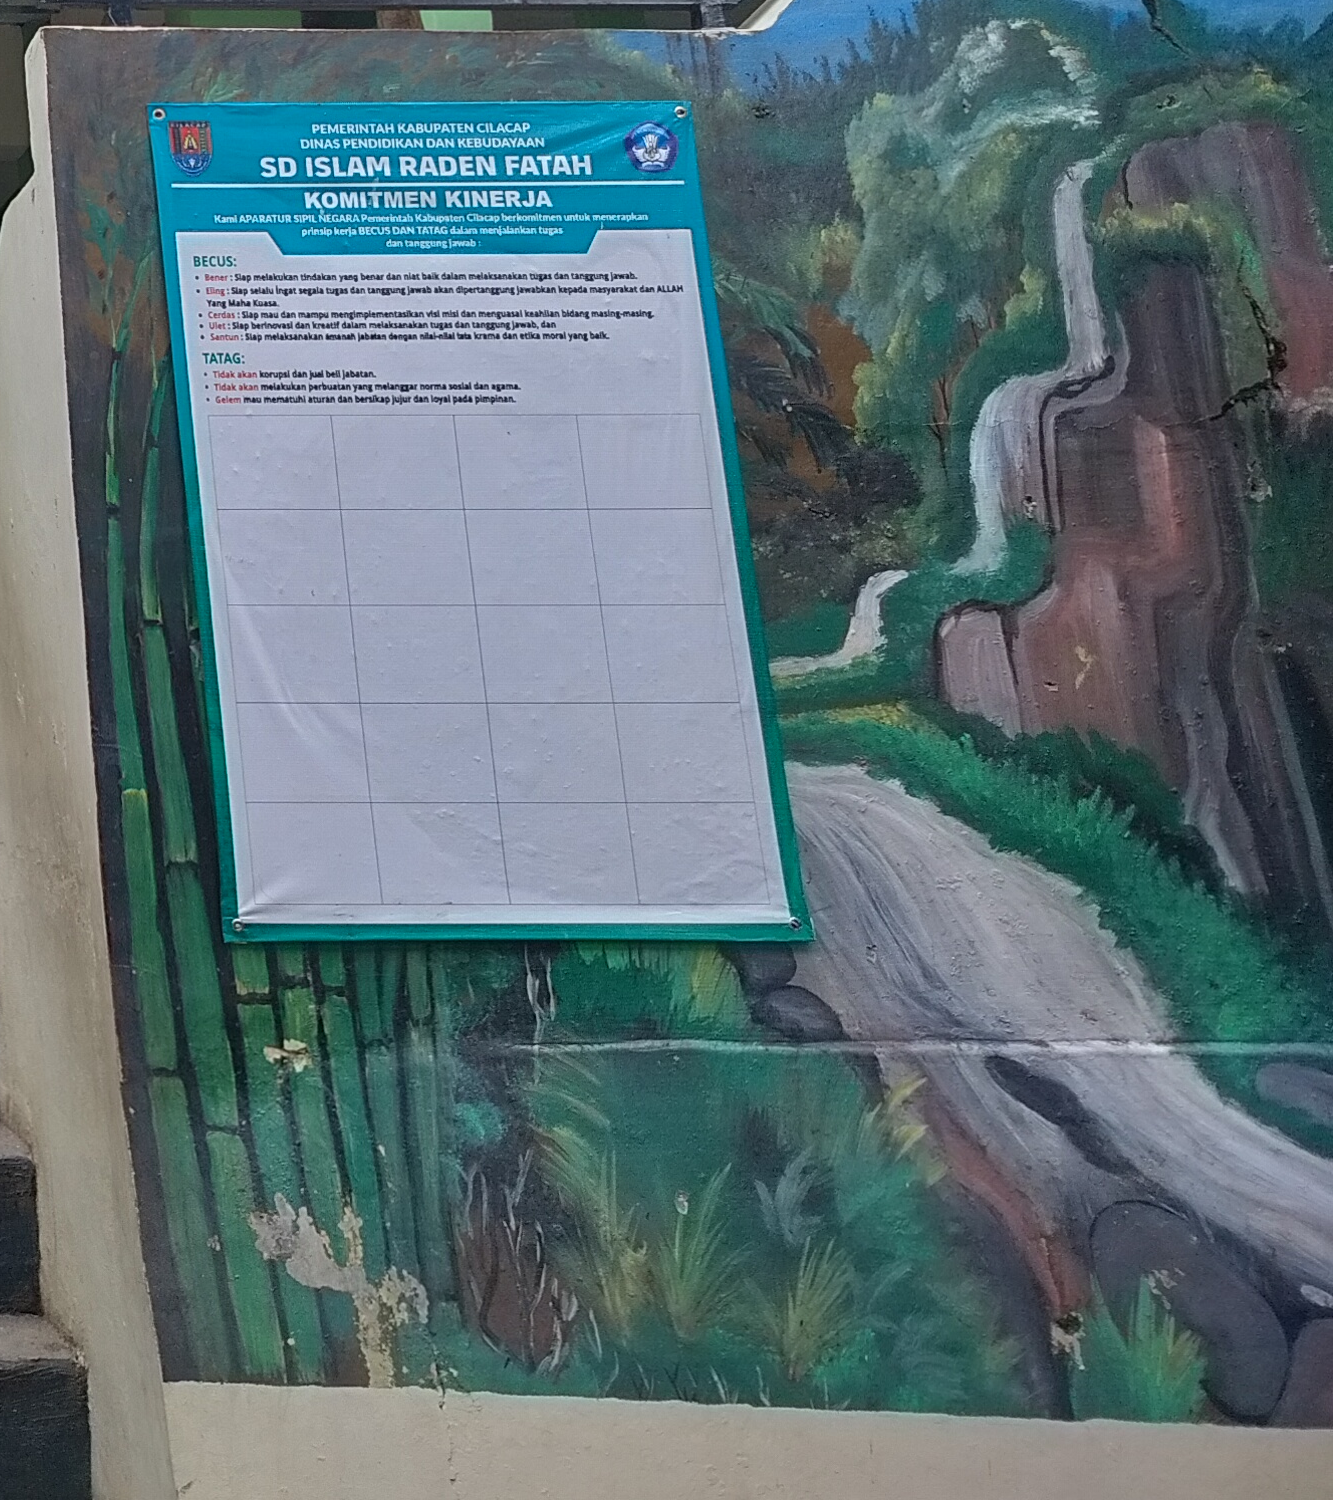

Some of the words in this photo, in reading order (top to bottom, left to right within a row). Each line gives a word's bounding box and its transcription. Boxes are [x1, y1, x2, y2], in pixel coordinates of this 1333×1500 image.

[312, 123, 395, 134] PEMERINTAH
[398, 122, 474, 134] KABUPATEN
[477, 122, 530, 133] CILACAP
[300, 138, 340, 149] DINAS
[343, 138, 423, 149] PENDIDIKAN
[426, 138, 455, 148] DAN
[458, 137, 545, 148] KEBUDAYAAN
[260, 157, 297, 178] SD
[305, 156, 391, 178] ISLAM
[399, 155, 496, 177] RADEN
[505, 154, 593, 176] FATAH
[304, 191, 436, 209] KOMITMEN
[445, 190, 553, 207] KINERJA
[213, 214, 238, 223] Kami
[239, 214, 292, 223] APARATUR
[293, 214, 317, 223] SIPIL
[318, 214, 360, 223] NEGARA
[361, 214, 413, 223] Pemerintah
[415, 213, 465, 223] Kabupaten
[466, 212, 500, 223] Cilacap
[501, 212, 562, 222] berkomitmen
[563, 212, 590, 222] untuk
[592, 212, 648, 223] menerapkan
[301, 227, 332, 237] prinsip
[334, 227, 357, 237] kerja
[358, 226, 390, 235] BECUS
[392, 226, 414, 235] DAN
[416, 226, 448, 234] TATAG
[450, 226, 477, 234] dalam
[480, 225, 537, 236] menjalankan
[538, 226, 563, 236] tugas
[386, 239, 403, 247] dan
[405, 240, 448, 249] tanggung
[449, 239, 476, 249] jawab
[193, 256, 237, 267] BECUS:
[234, 273, 251, 283] Siap
[253, 273, 298, 281] melakukan
[300, 273, 336, 281] tindakan
[339, 274, 358, 282] yang
[422, 272, 440, 280] baik
[441, 272, 466, 280] dalam
[468, 272, 527, 280] melaksanakan
[530, 272, 552, 282] tugas
[554, 272, 569, 280] dan
[571, 272, 608, 282] tanggung
[610, 272, 638, 282] jawab.
[206, 287, 225, 296] Eling
[231, 287, 248, 296] Siap
[299, 287, 324, 296] segala
[326, 287, 348, 296] tugas
[350, 286, 365, 294] dan
[367, 287, 405, 296] tanggung
[407, 286, 432, 295] jawab
[434, 286, 454, 294] akan
[456, 286, 515, 295] dipertanggung
[516, 285, 556, 295] jawabkan
[558, 285, 587, 295] kepada
[590, 285, 638, 295] masyarakat
[639, 285, 655, 293] dan
[657, 285, 683, 293] ALLAH
[208, 311, 235, 319] Cerdas
[241, 311, 259, 320] Siap
[281, 311, 296, 319] dan
[298, 312, 329, 320] mampu
[331, 310, 424, 320] mengimplementasikan
[426, 310, 440, 318] visi
[478, 310, 523, 320] menguasai
[562, 309, 590, 319] bidang
[232, 322, 249, 331] Siap
[251, 321, 293, 329] berinovasi
[312, 321, 340, 329] kreatif
[342, 321, 367, 329] dalam
[369, 321, 428, 329] melaksanakan
[430, 322, 453, 331] tugas
[472, 322, 510, 331] tanggung
[512, 321, 539, 330] jawab,
[541, 320, 556, 328] dan
[202, 353, 245, 364] TATAG:
[237, 370, 257, 378] akan
[259, 370, 290, 380] korupsi
[292, 369, 307, 378] dan
[309, 369, 324, 380] jual
[325, 370, 340, 378] beli
[342, 369, 377, 380] jabatan.
[238, 383, 259, 391] akan
[261, 383, 306, 391] melakukan
[309, 383, 351, 392] perbuatan
[353, 384, 373, 392] yang
[374, 382, 417, 392] melanggar
[449, 382, 472, 390] sosial
[474, 382, 489, 390] dan
[491, 383, 521, 392] agama.
